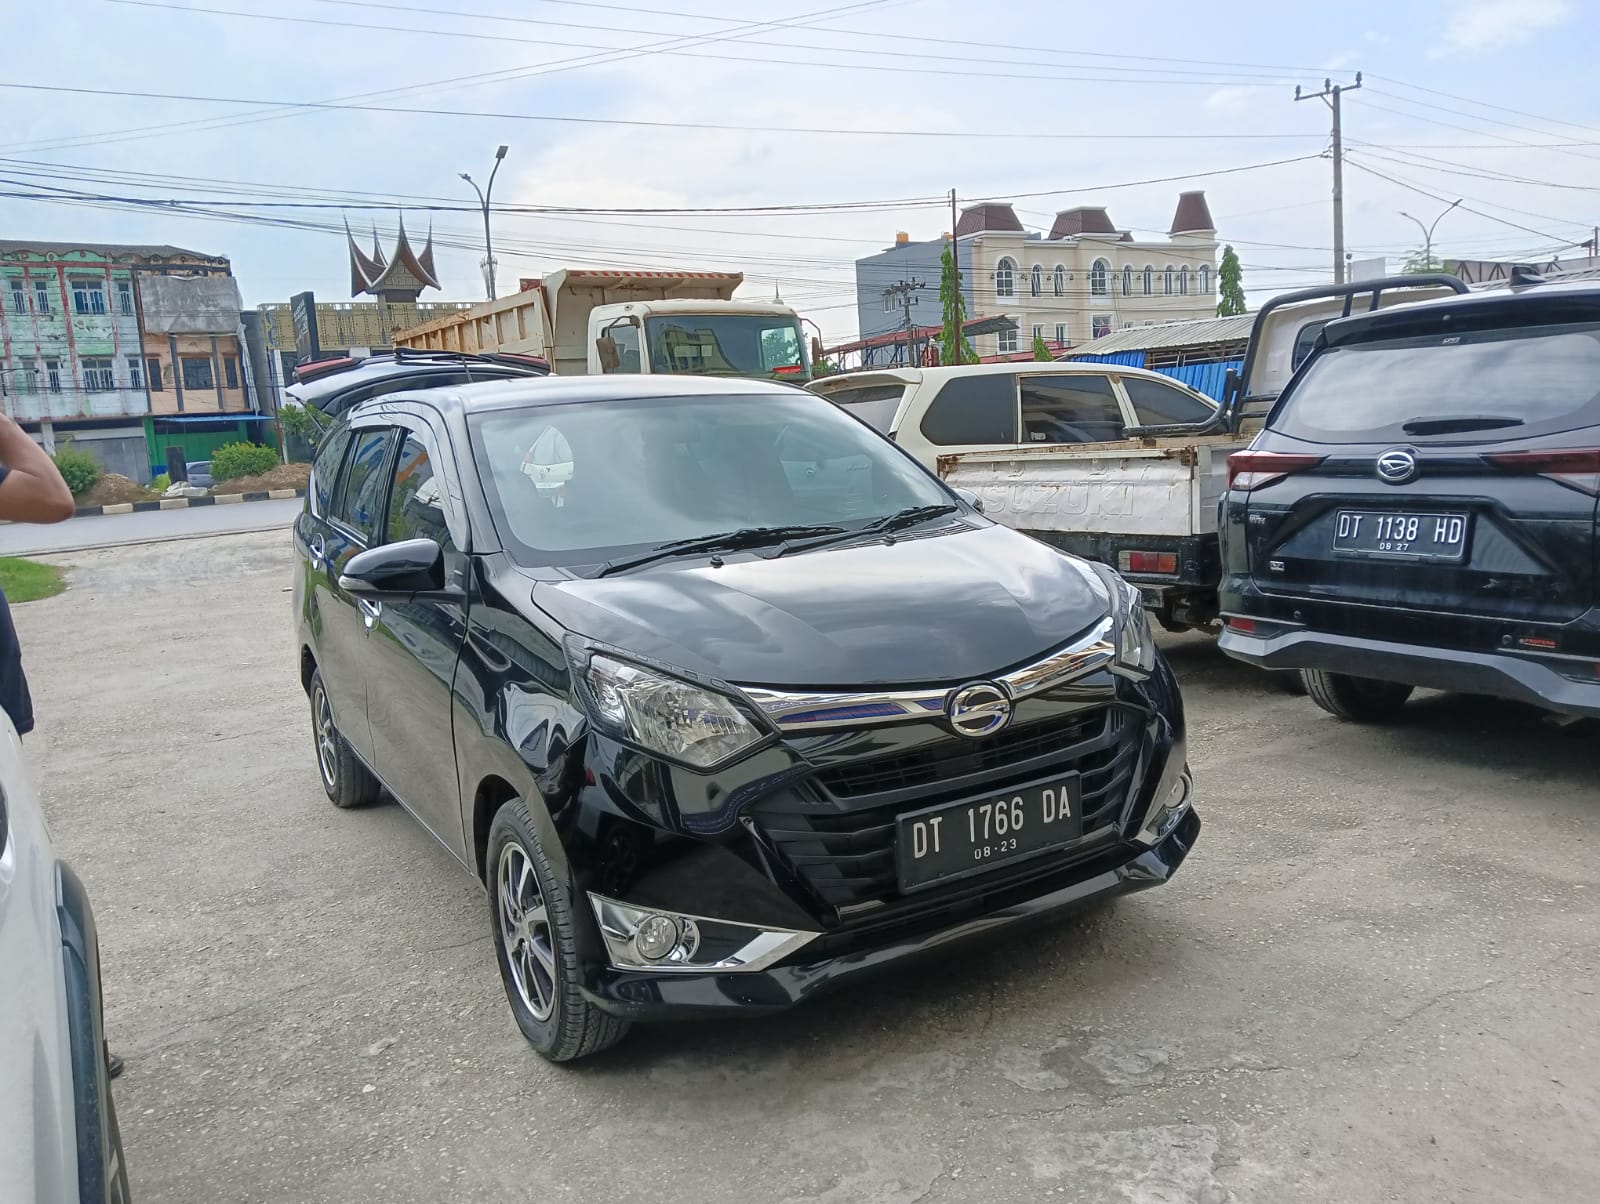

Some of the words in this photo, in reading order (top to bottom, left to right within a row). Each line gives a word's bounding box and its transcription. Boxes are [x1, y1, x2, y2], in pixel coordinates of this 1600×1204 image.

[982, 481, 1135, 516] SUZUKI
[1339, 514, 1362, 538] DT
[1376, 516, 1419, 541] 1138
[1433, 518, 1461, 544] HD
[1379, 542, 1392, 551] 08
[1396, 543, 1409, 551] 27
[913, 816, 943, 859] DT
[967, 796, 1024, 843] 1766
[1042, 785, 1071, 824] DA
